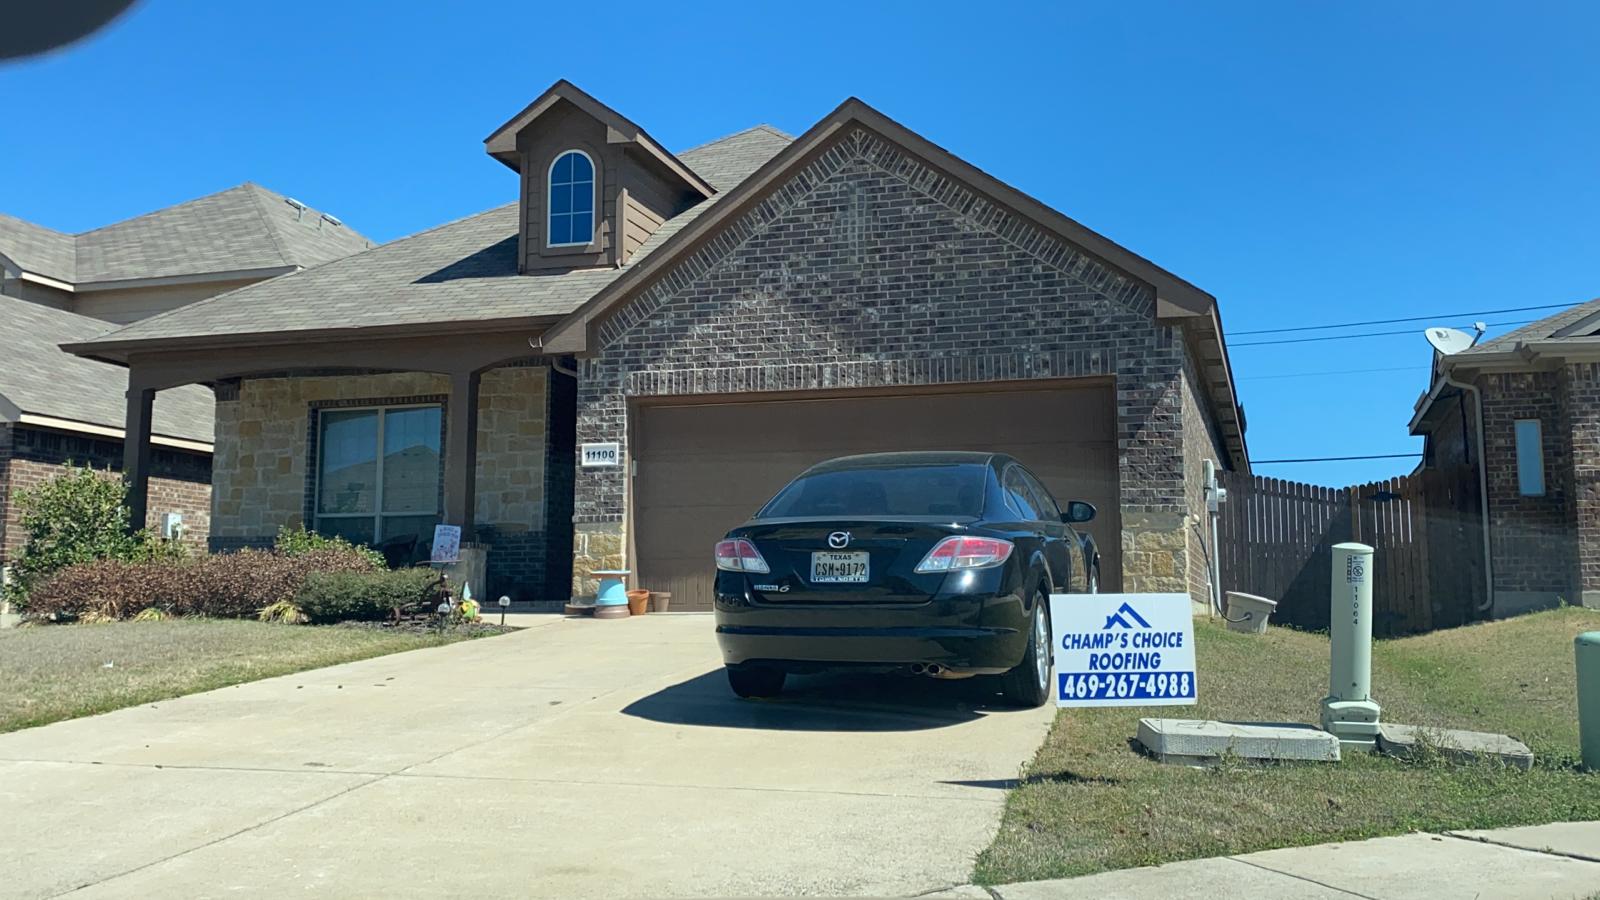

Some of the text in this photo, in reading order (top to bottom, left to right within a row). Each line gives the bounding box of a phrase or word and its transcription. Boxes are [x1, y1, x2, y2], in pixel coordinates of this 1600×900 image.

[586, 450, 615, 459] 11100
[1062, 632, 1183, 650] CHAMP'S CHOICE
[1089, 652, 1161, 670] ROOFING
[1064, 673, 1189, 698] 469-267-4988
